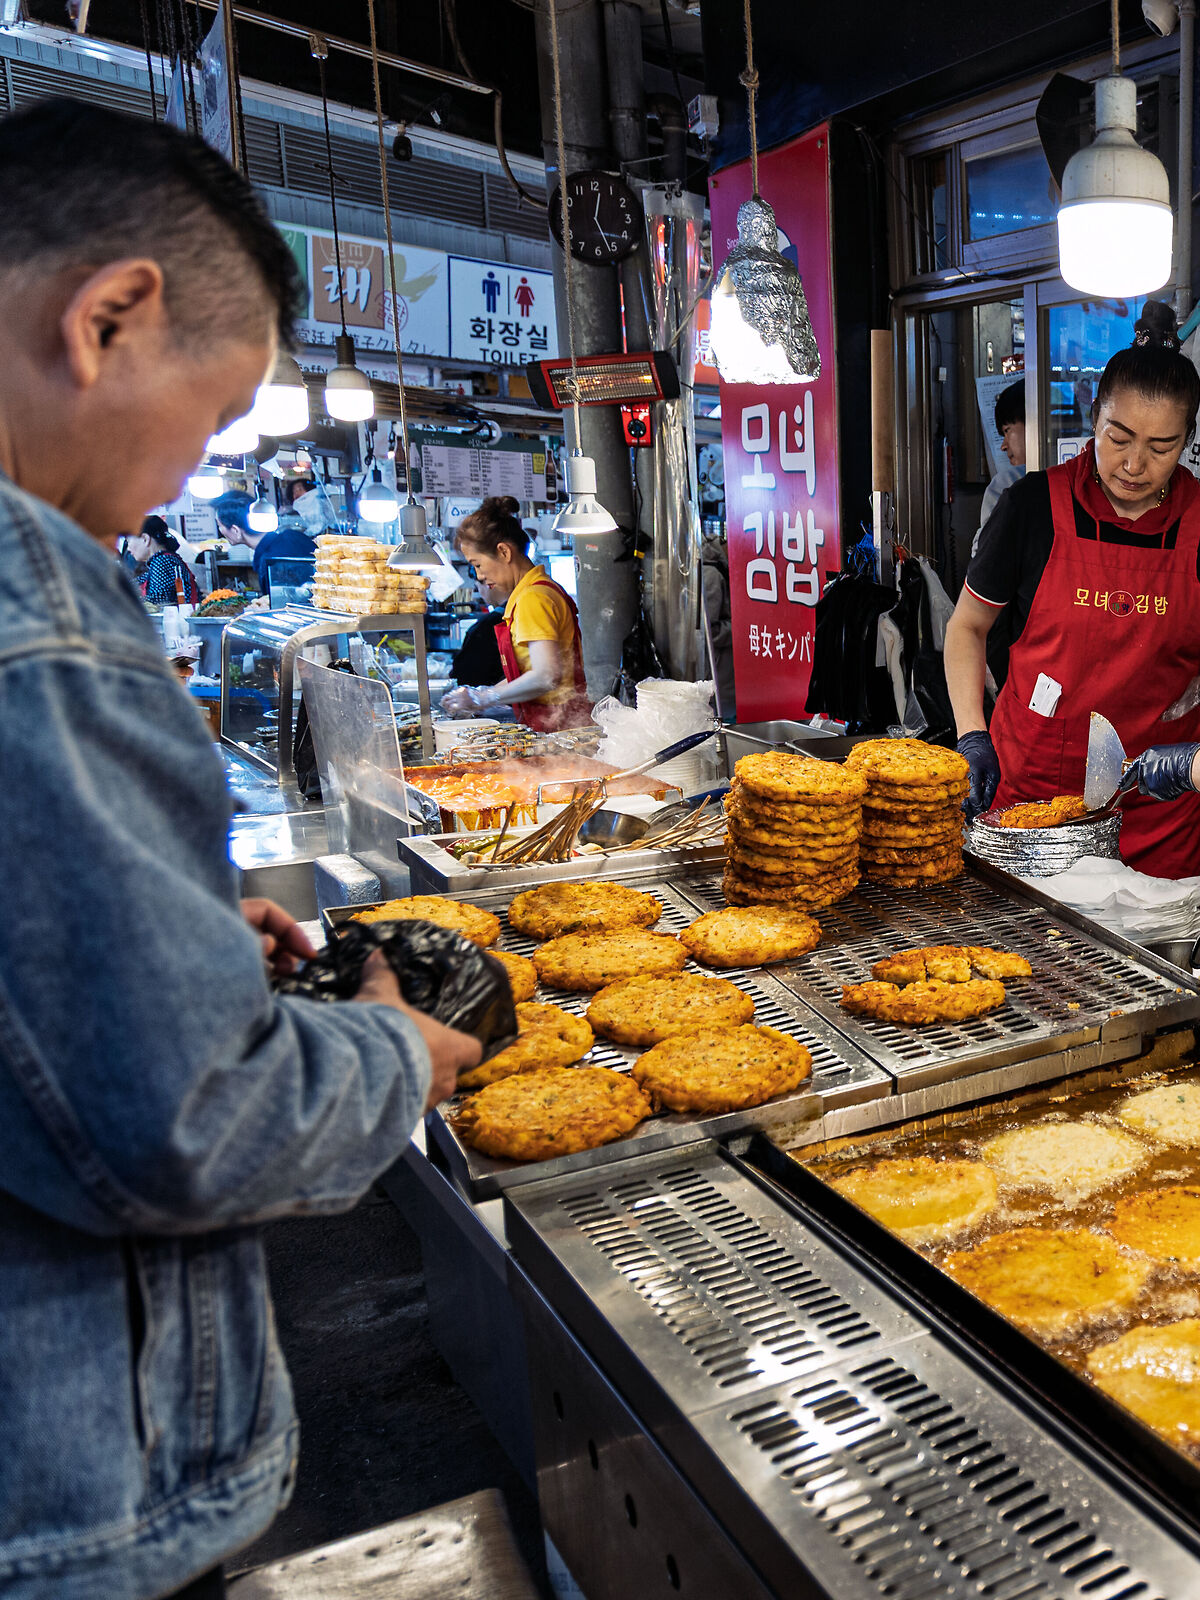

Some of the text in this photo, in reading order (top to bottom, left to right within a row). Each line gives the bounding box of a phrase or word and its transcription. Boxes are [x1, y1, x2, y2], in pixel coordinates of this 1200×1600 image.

[576, 186, 583, 195] 11
[590, 181, 599, 191] 12
[620, 198, 626, 208] 2
[625, 214, 632, 224] 3
[621, 230, 628, 240] 4
[579, 242, 585, 251] 7
[595, 247, 602, 256] 6
[611, 242, 618, 251] 5
[470, 317, 548, 350] 화장실
[479, 347, 538, 366] TOILET
[741, 390, 816, 497] 모녀
[743, 509, 826, 609] 김밥
[1073, 588, 1109, 612] 모녀
[1135, 594, 1169, 615] 김밥
[749, 624, 815, 664] 母女キンパ
